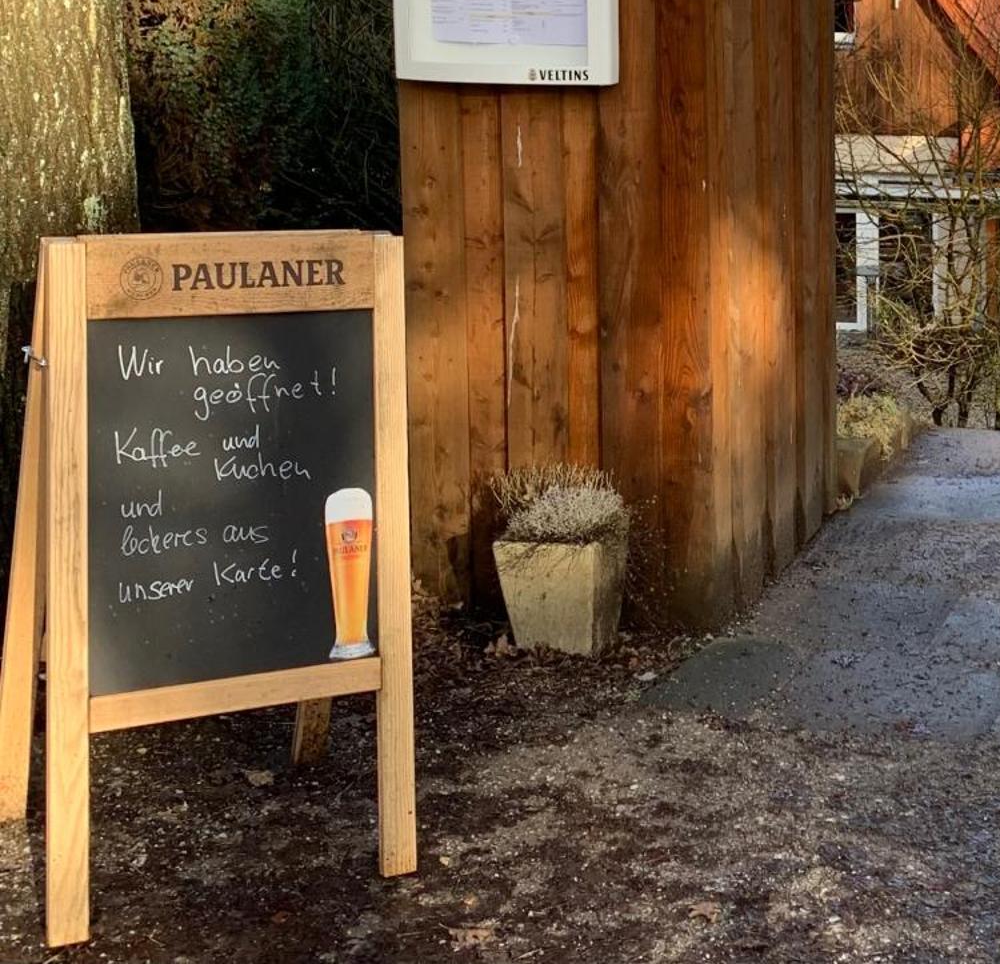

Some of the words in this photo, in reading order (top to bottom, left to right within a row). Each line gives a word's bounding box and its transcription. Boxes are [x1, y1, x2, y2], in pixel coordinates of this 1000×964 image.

[539, 69, 589, 81] VELTINS
[171, 258, 345, 292] PAULANER
[118, 344, 164, 380] Wir
[188, 344, 281, 376] haben
[193, 366, 337, 421] geöffnet!
[114, 427, 201, 468] Kaffee
[222, 424, 260, 451] und
[214, 451, 311, 481] Kuchen
[120, 489, 162, 518] und
[222, 524, 269, 544] aus
[213, 549, 297, 586] Karte!
